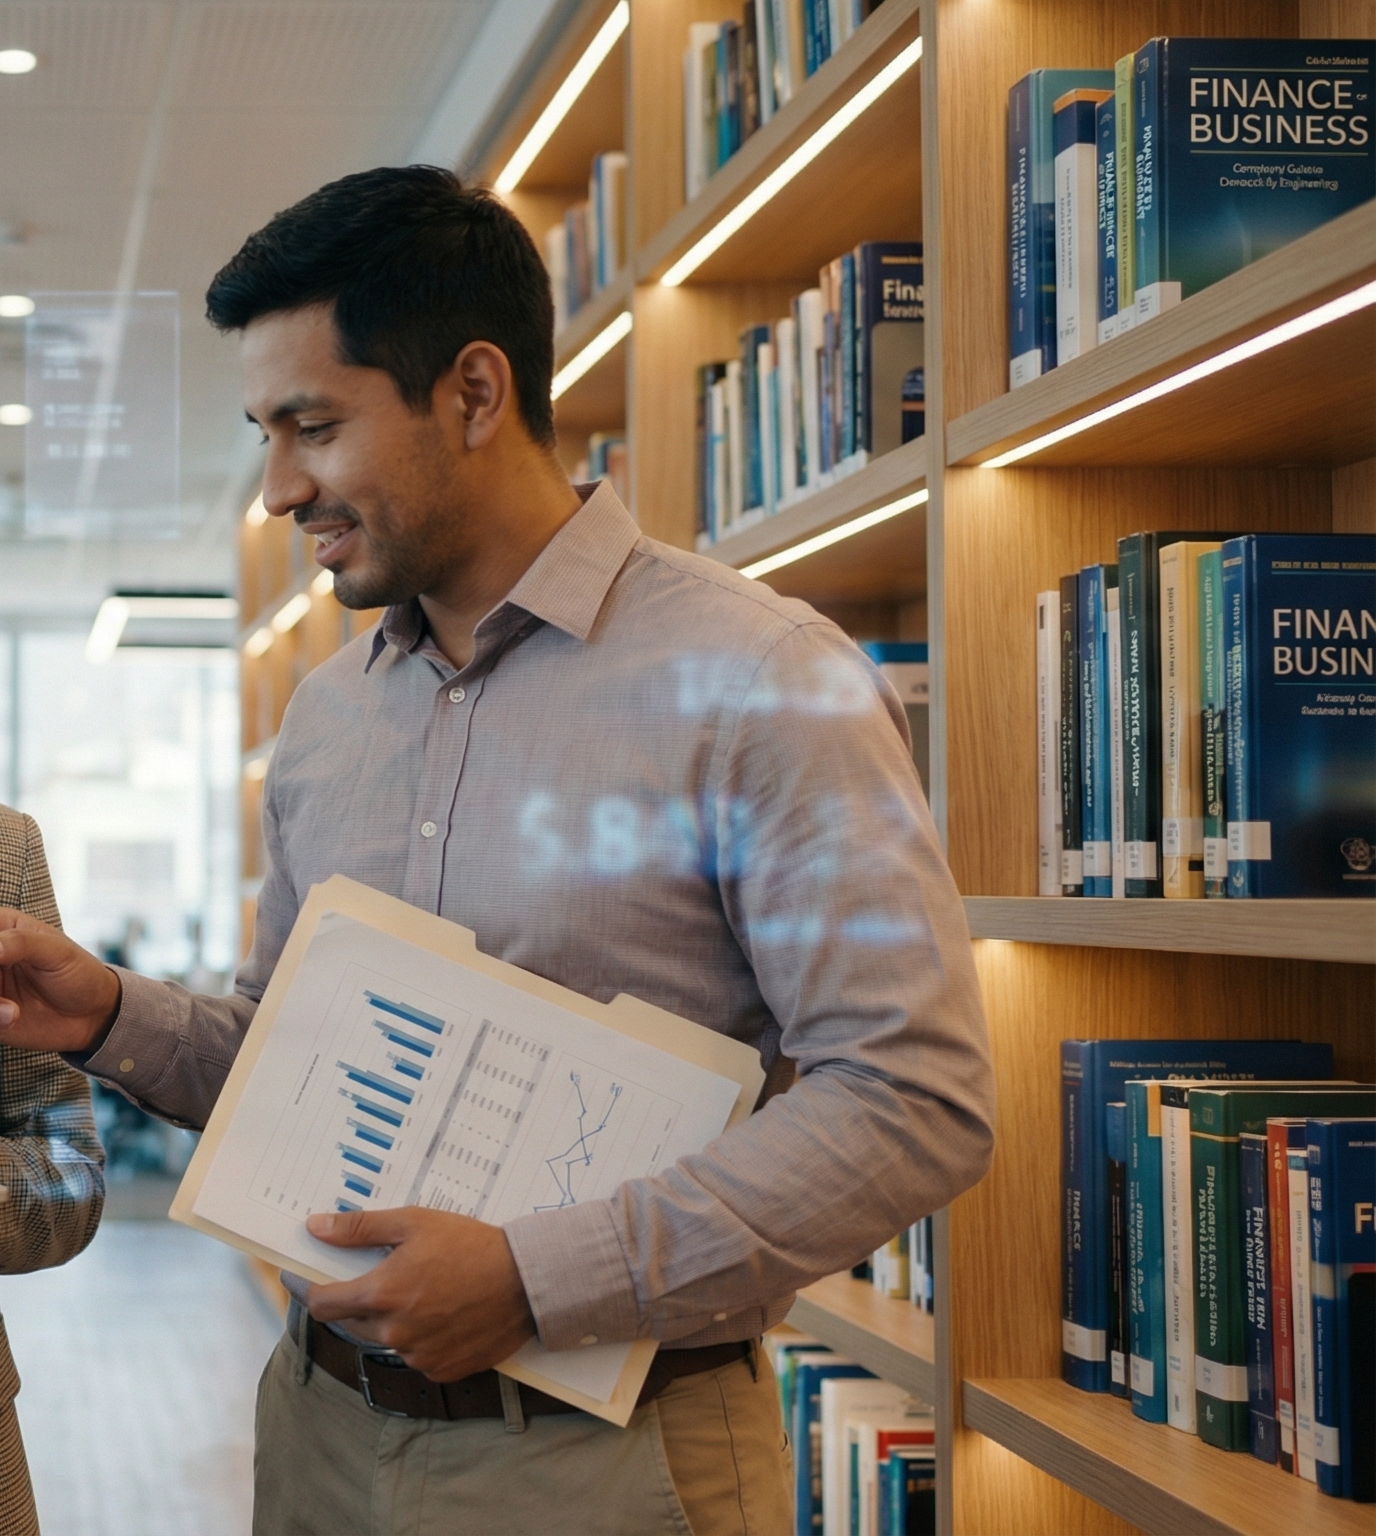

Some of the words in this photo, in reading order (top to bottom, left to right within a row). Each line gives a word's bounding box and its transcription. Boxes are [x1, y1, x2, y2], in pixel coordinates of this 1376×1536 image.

[1190, 77, 1354, 110] FINANCE
[1190, 113, 1369, 146] BUSINESS
[1273, 646, 1374, 676] BUSIN
